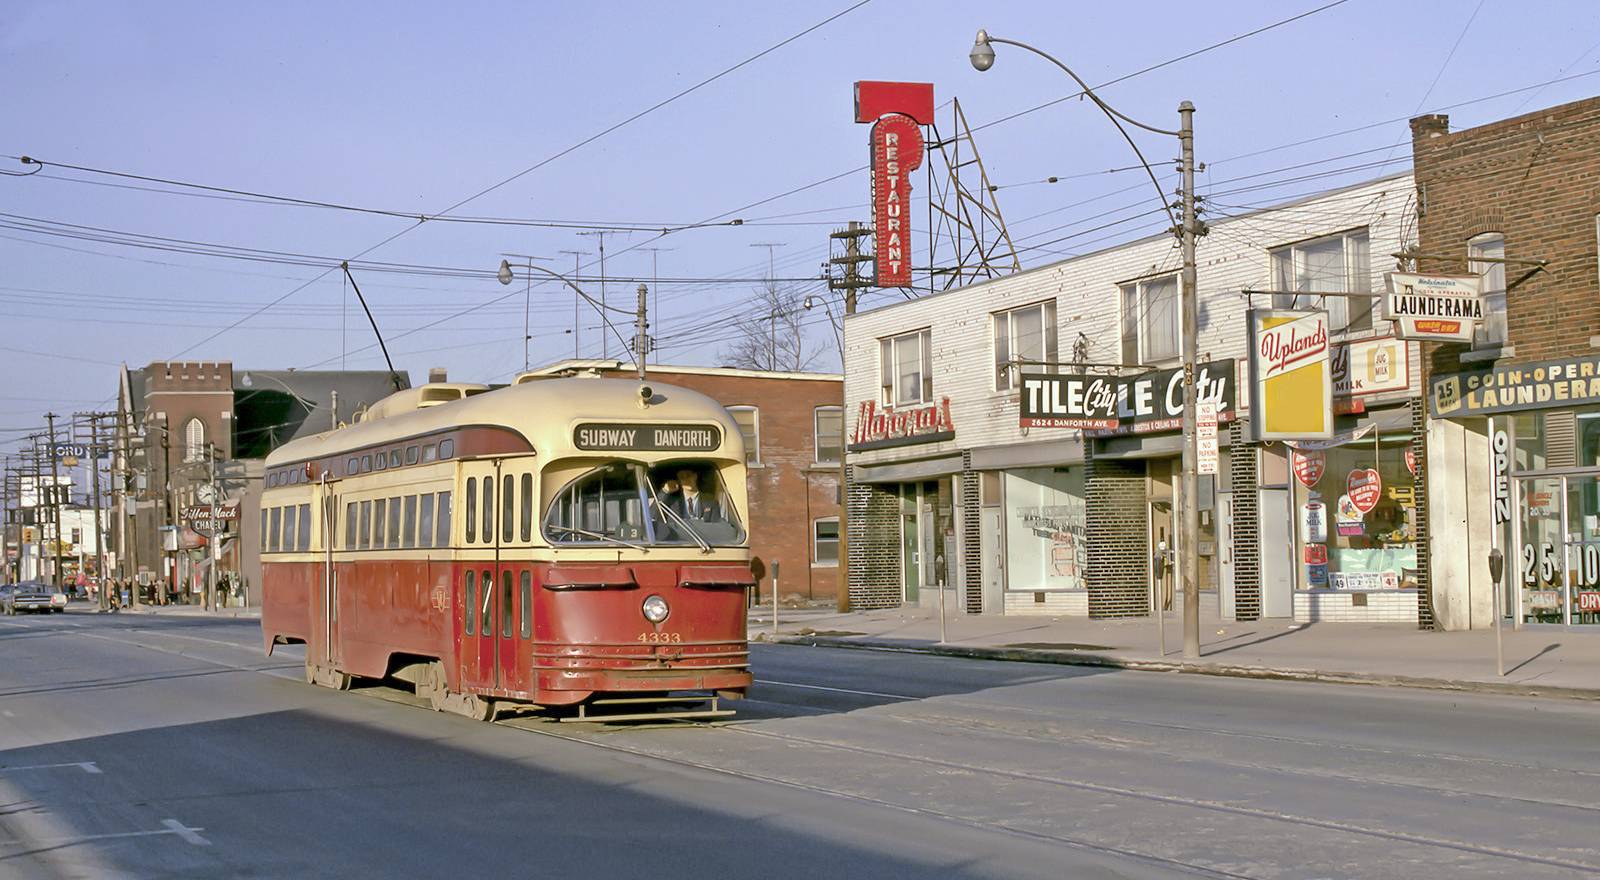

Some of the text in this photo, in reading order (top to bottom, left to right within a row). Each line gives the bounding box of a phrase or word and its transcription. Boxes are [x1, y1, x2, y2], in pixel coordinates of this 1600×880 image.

[885, 133, 901, 274] RESTAURANT
[1394, 295, 1482, 318] LAUNDERAMA
[1261, 319, 1327, 370] Uplands
[1375, 366, 1388, 376] MILK
[1467, 361, 1600, 389] COIN-OPER
[1165, 367, 1227, 415] Cty
[1335, 379, 1363, 391] MILK
[1025, 379, 1117, 416] TILE City
[1201, 406, 1211, 414] NO
[1031, 418, 1052, 426] 2624
[1054, 419, 1091, 427] DANFORTH
[580, 429, 711, 447] SUBWAY DANFORTH
[1202, 441, 1212, 449] NO
[1493, 430, 1511, 524] OPEN
[1524, 543, 1555, 584] 25
[637, 632, 681, 644] 4333
